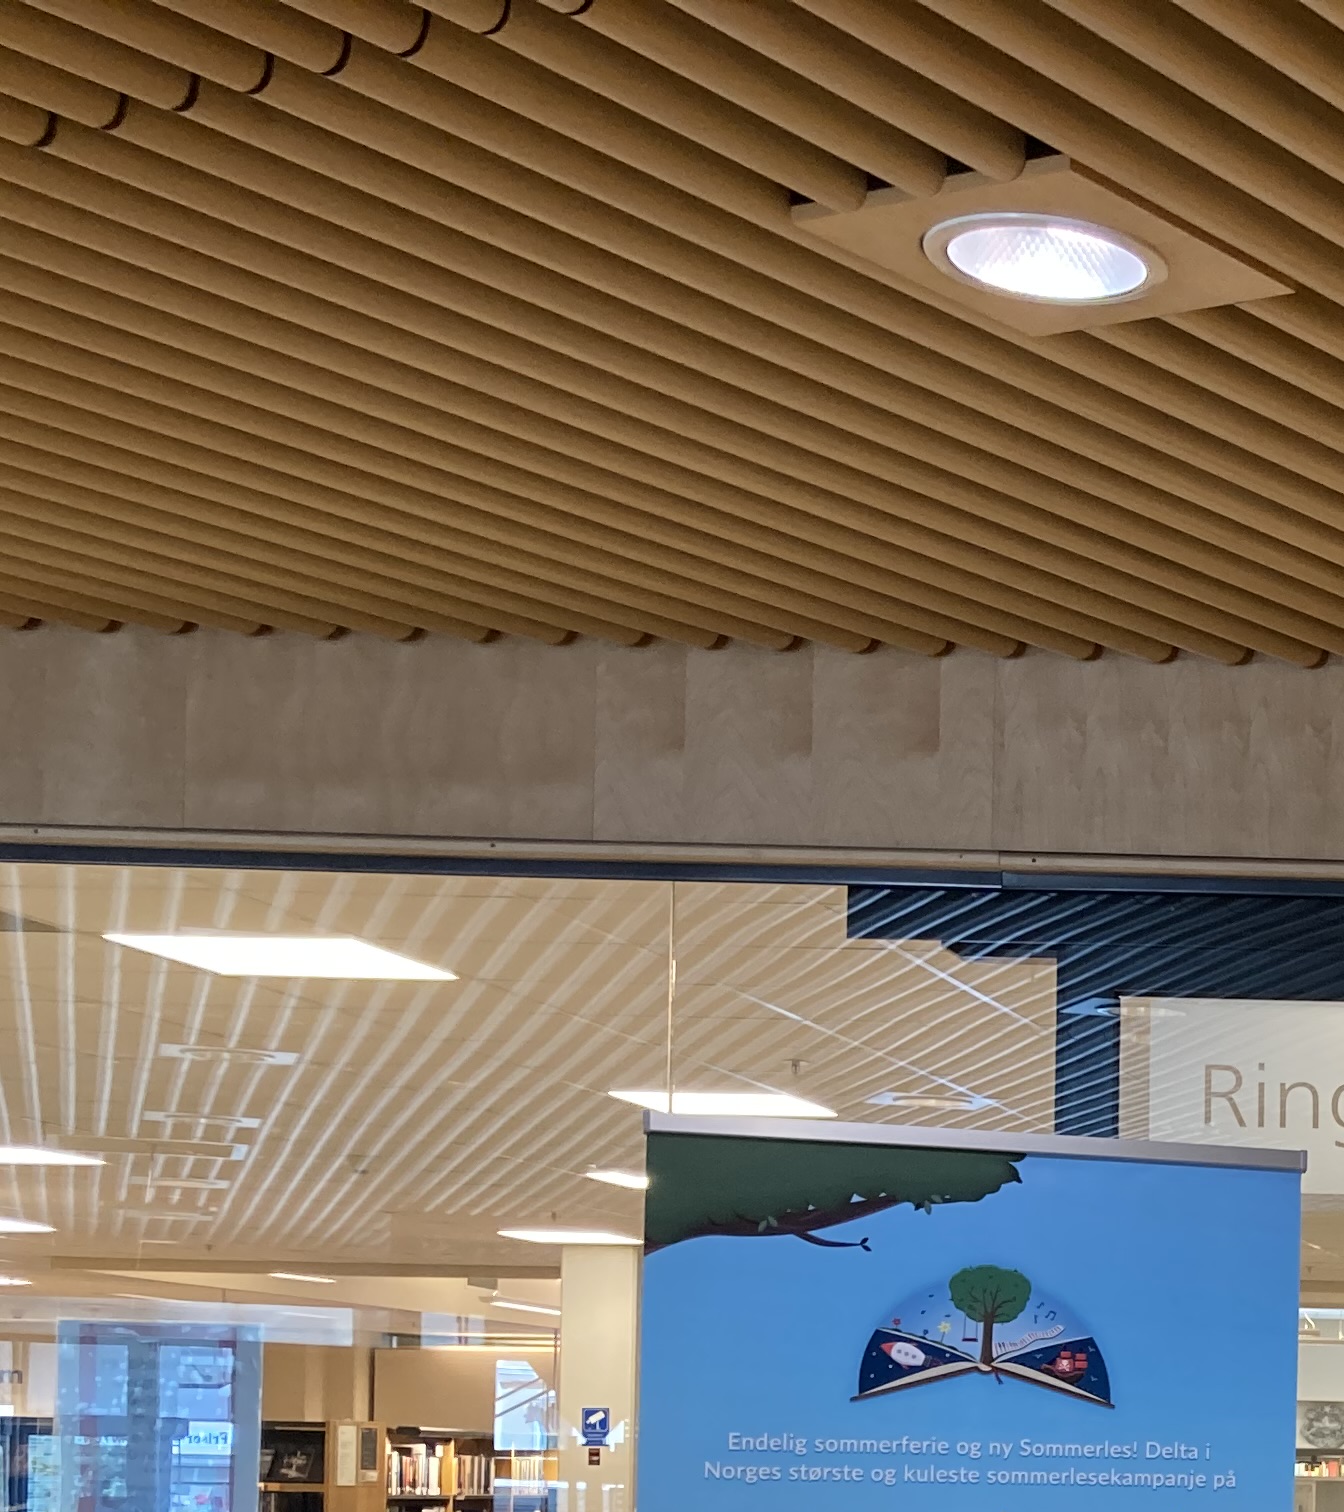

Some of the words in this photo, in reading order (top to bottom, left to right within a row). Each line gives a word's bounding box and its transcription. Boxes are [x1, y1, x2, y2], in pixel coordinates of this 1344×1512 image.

[729, 1432, 807, 1454] Endelig
[815, 1436, 949, 1453] sommerferie
[957, 1442, 981, 1458] og
[990, 1443, 1013, 1458] ny
[1020, 1439, 1137, 1457] Sommerles!
[1146, 1442, 1197, 1458] Delta
[1206, 1443, 1210, 1459] i
[705, 1462, 781, 1483] Norges
[789, 1464, 863, 1480] største
[871, 1469, 896, 1485] og
[904, 1464, 979, 1482] kuleste
[987, 1468, 1206, 1489] sommerlesekampanje
[1214, 1470, 1235, 1489] på
